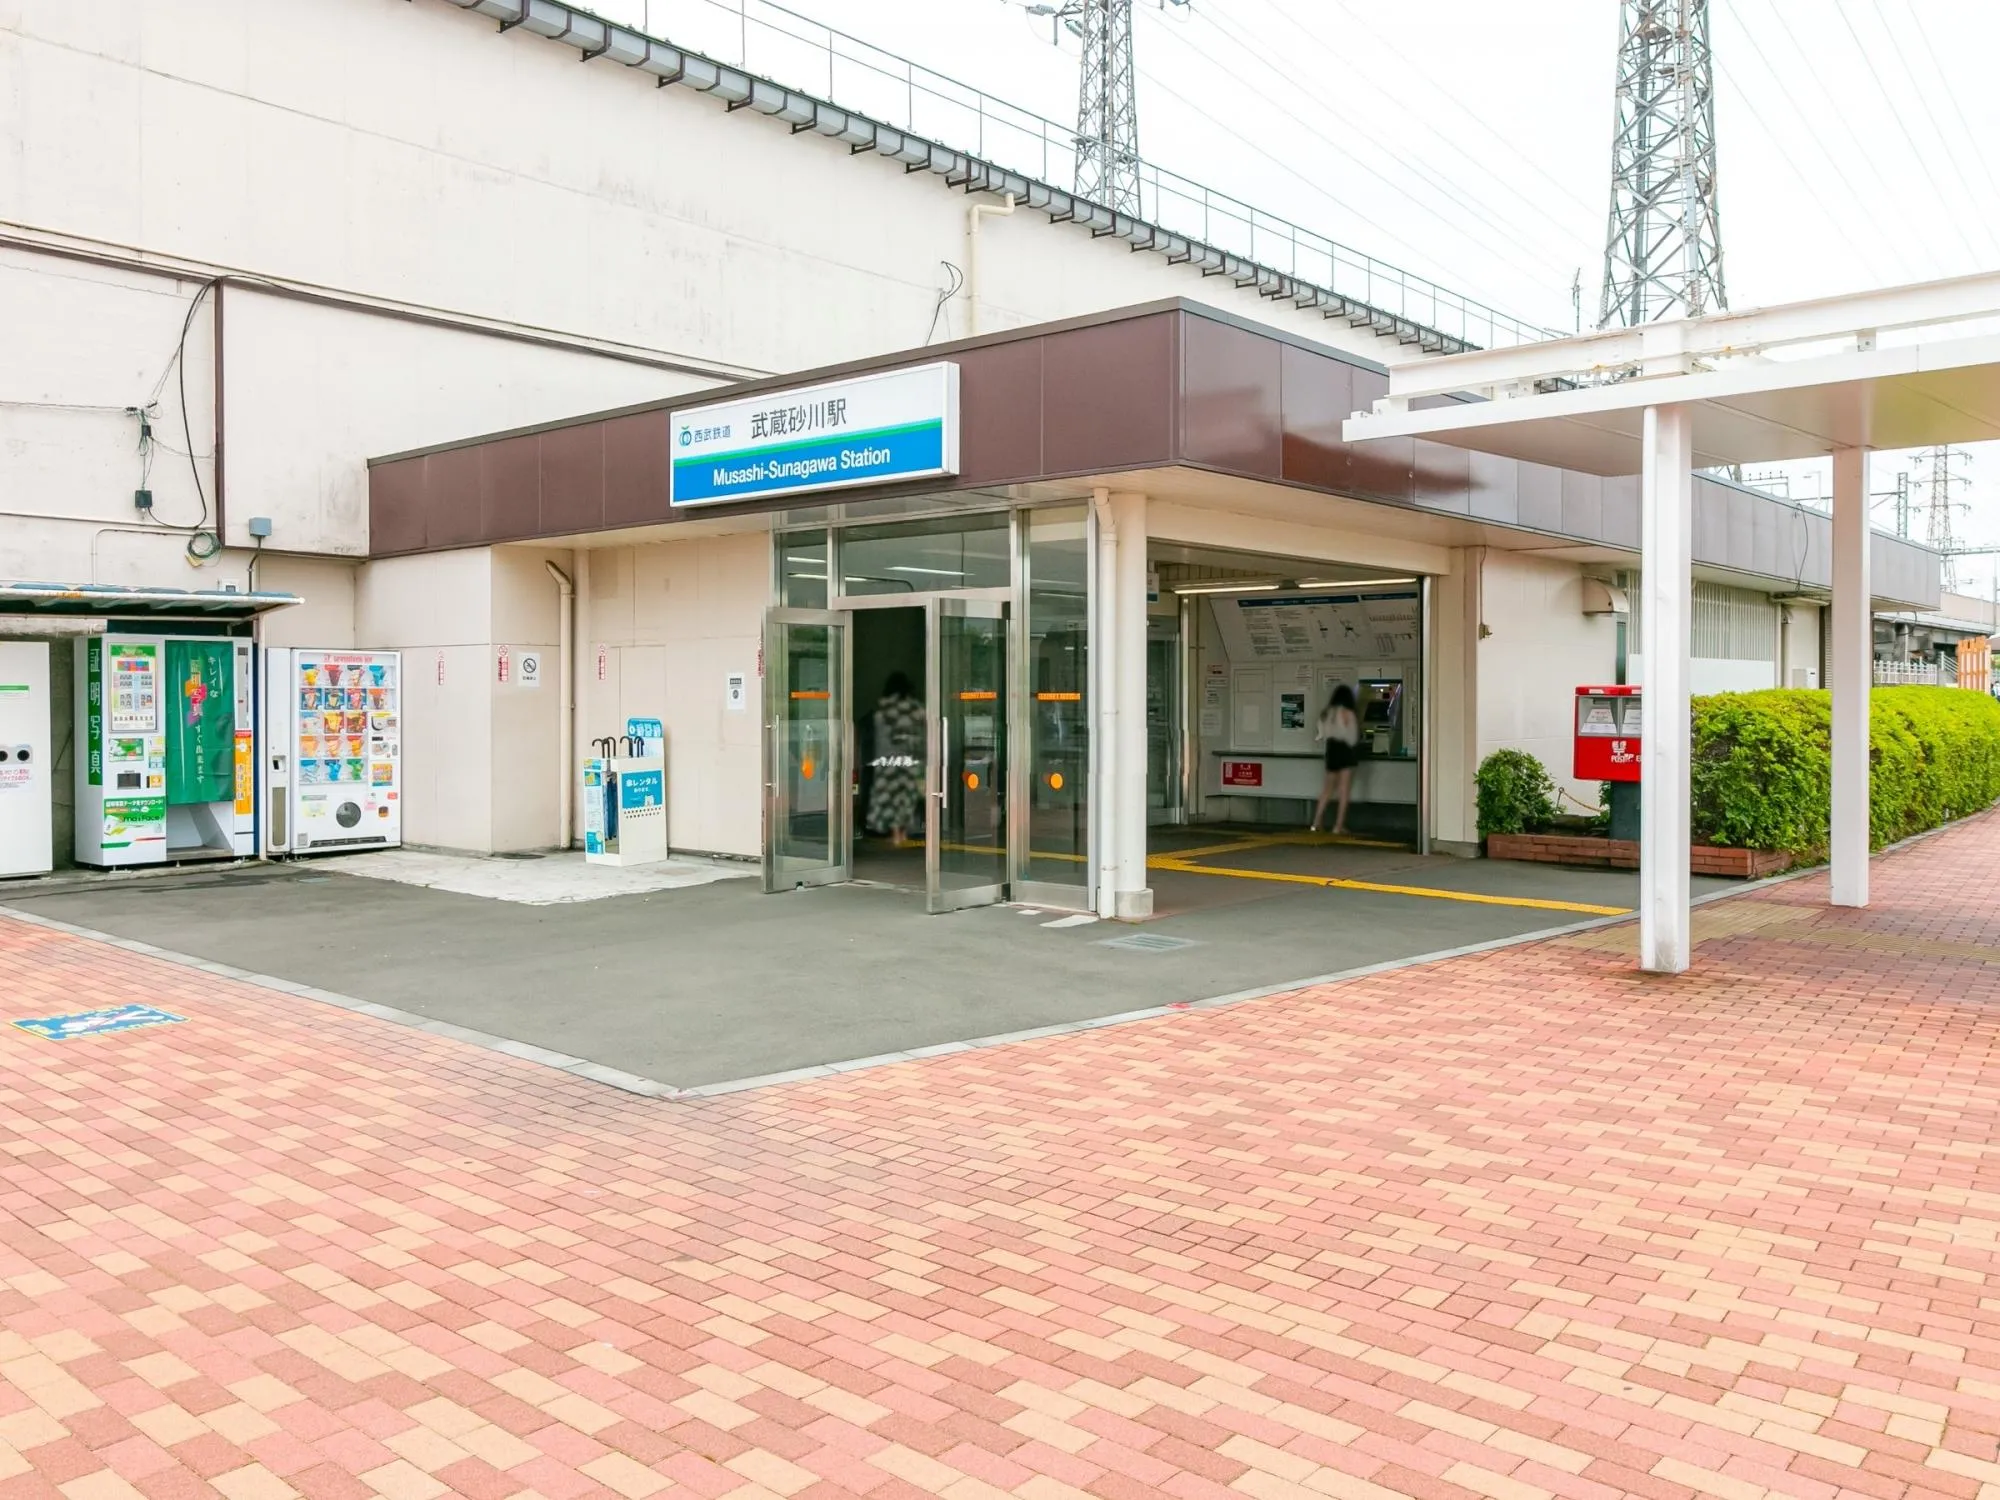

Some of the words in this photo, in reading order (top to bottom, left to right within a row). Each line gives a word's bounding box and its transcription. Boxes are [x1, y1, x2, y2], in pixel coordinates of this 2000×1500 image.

[694, 424, 731, 443] 西武鉄道
[751, 398, 847, 440] 武蔵砂川駅
[713, 457, 837, 487] Musashi-Sunagawa
[840, 446, 891, 470] Station
[208, 656, 219, 698] キレイな
[90, 648, 101, 774] 証明写真
